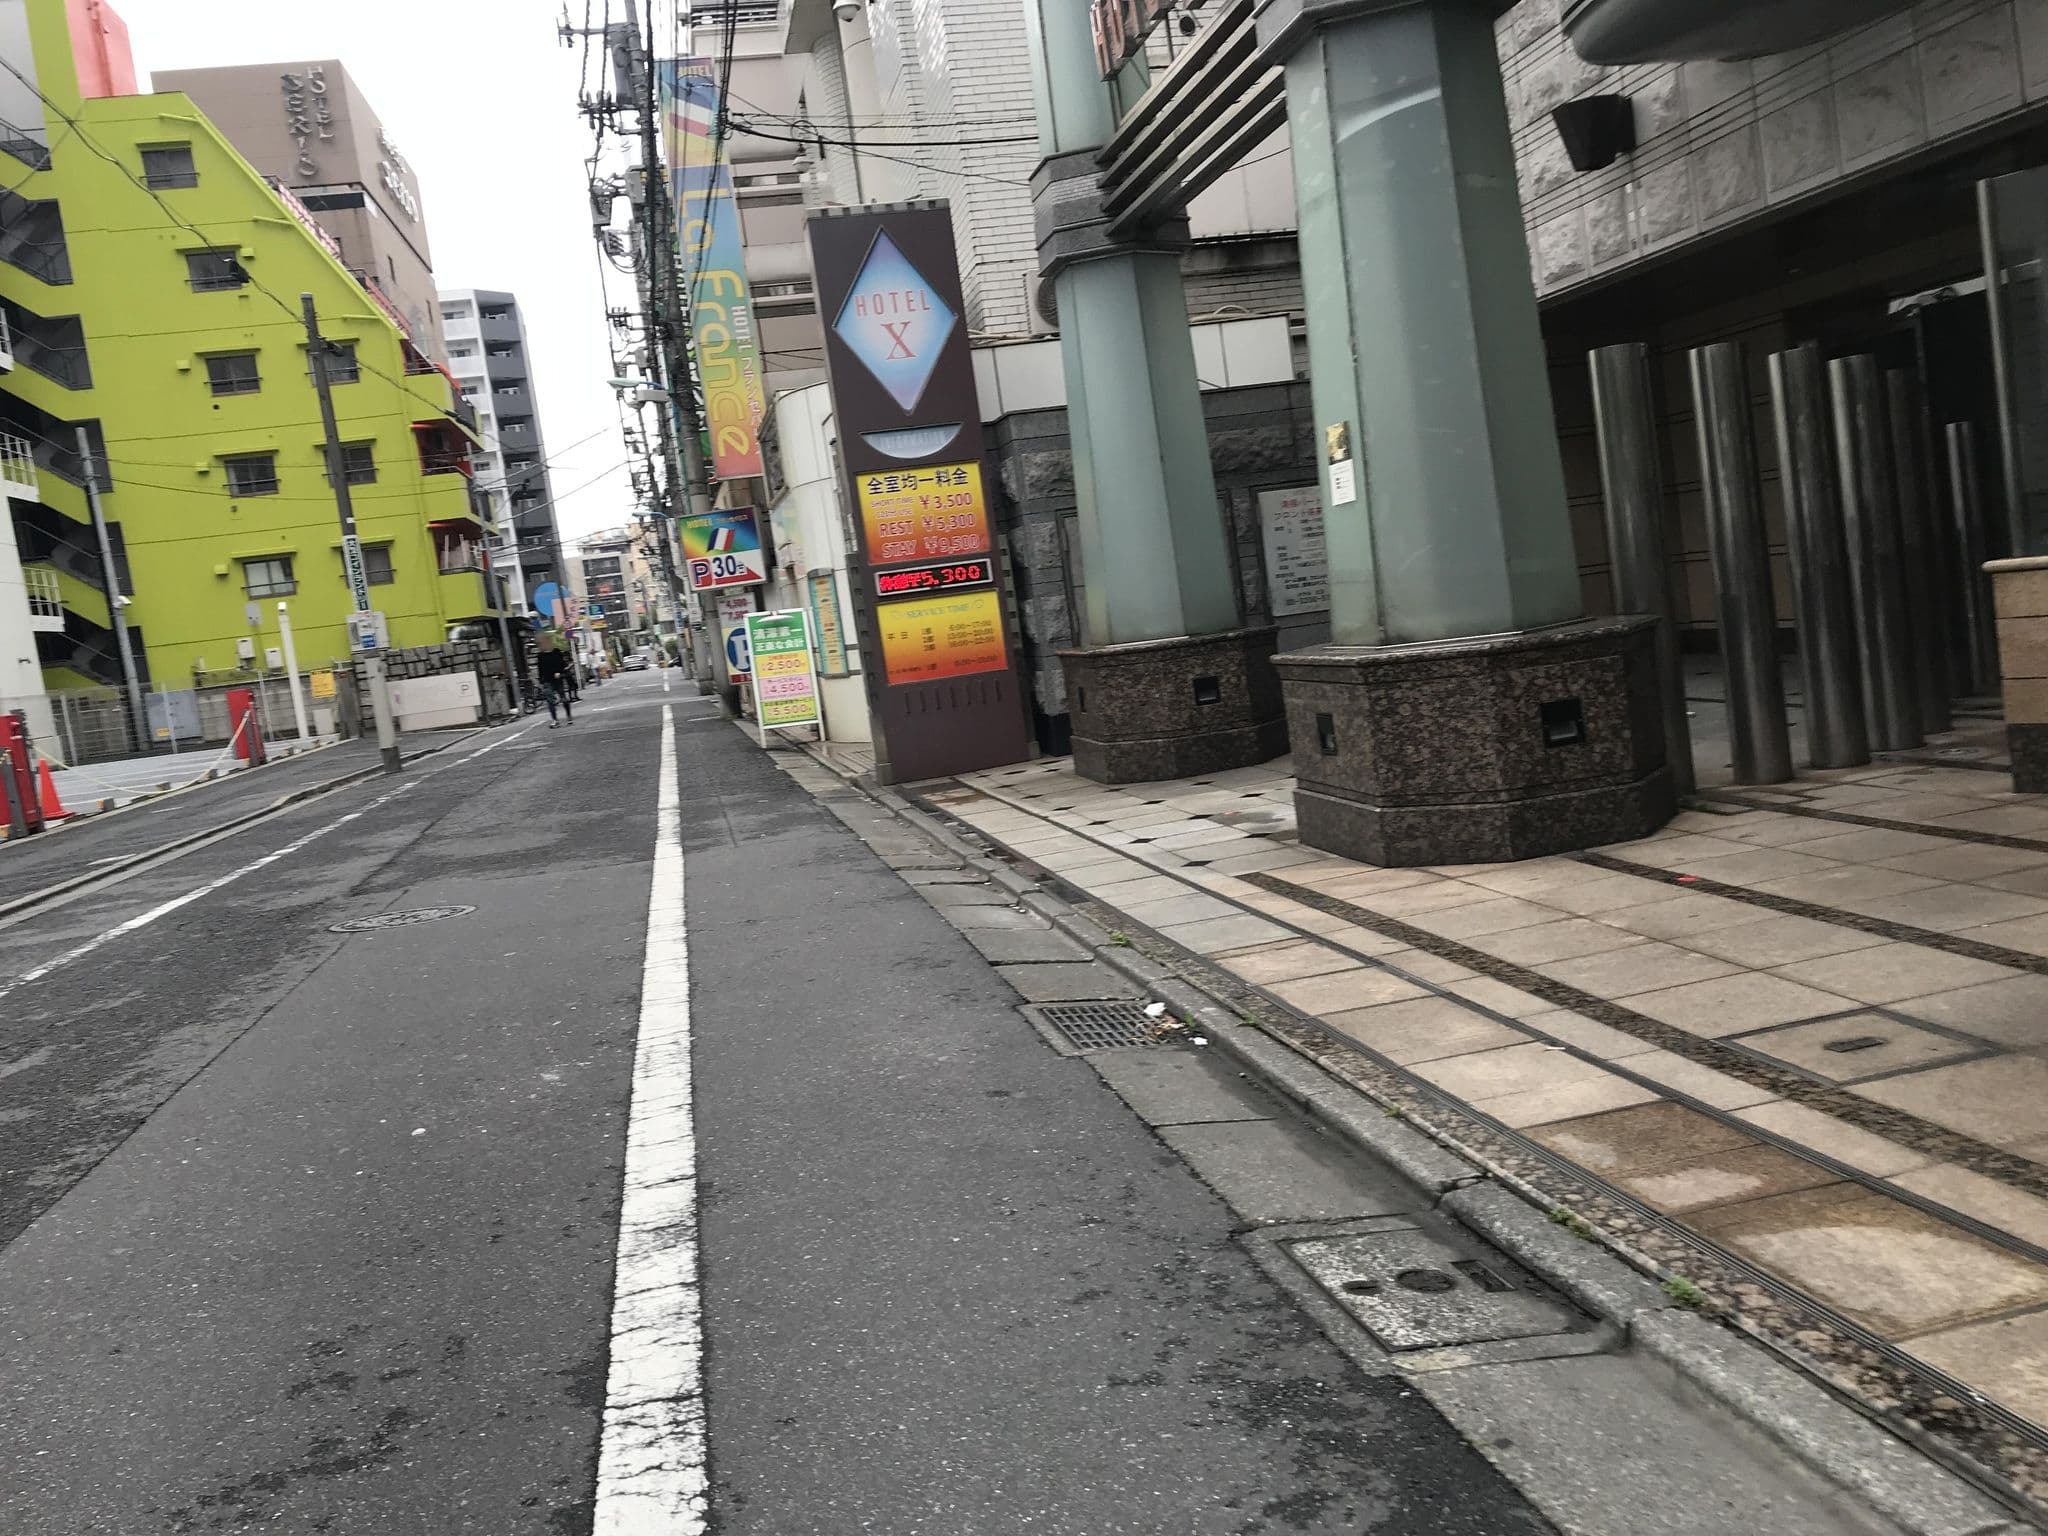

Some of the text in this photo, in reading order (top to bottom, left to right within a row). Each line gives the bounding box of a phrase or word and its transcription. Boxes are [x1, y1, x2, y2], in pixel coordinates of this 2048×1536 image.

[307, 66, 335, 141] HOTEL
[855, 289, 931, 316] HOTEL
[731, 305, 752, 351] HOTEL
[880, 321, 918, 360] X
[867, 467, 968, 494] 全室均一料金
[880, 520, 914, 537] REST
[882, 539, 917, 558] STAY
